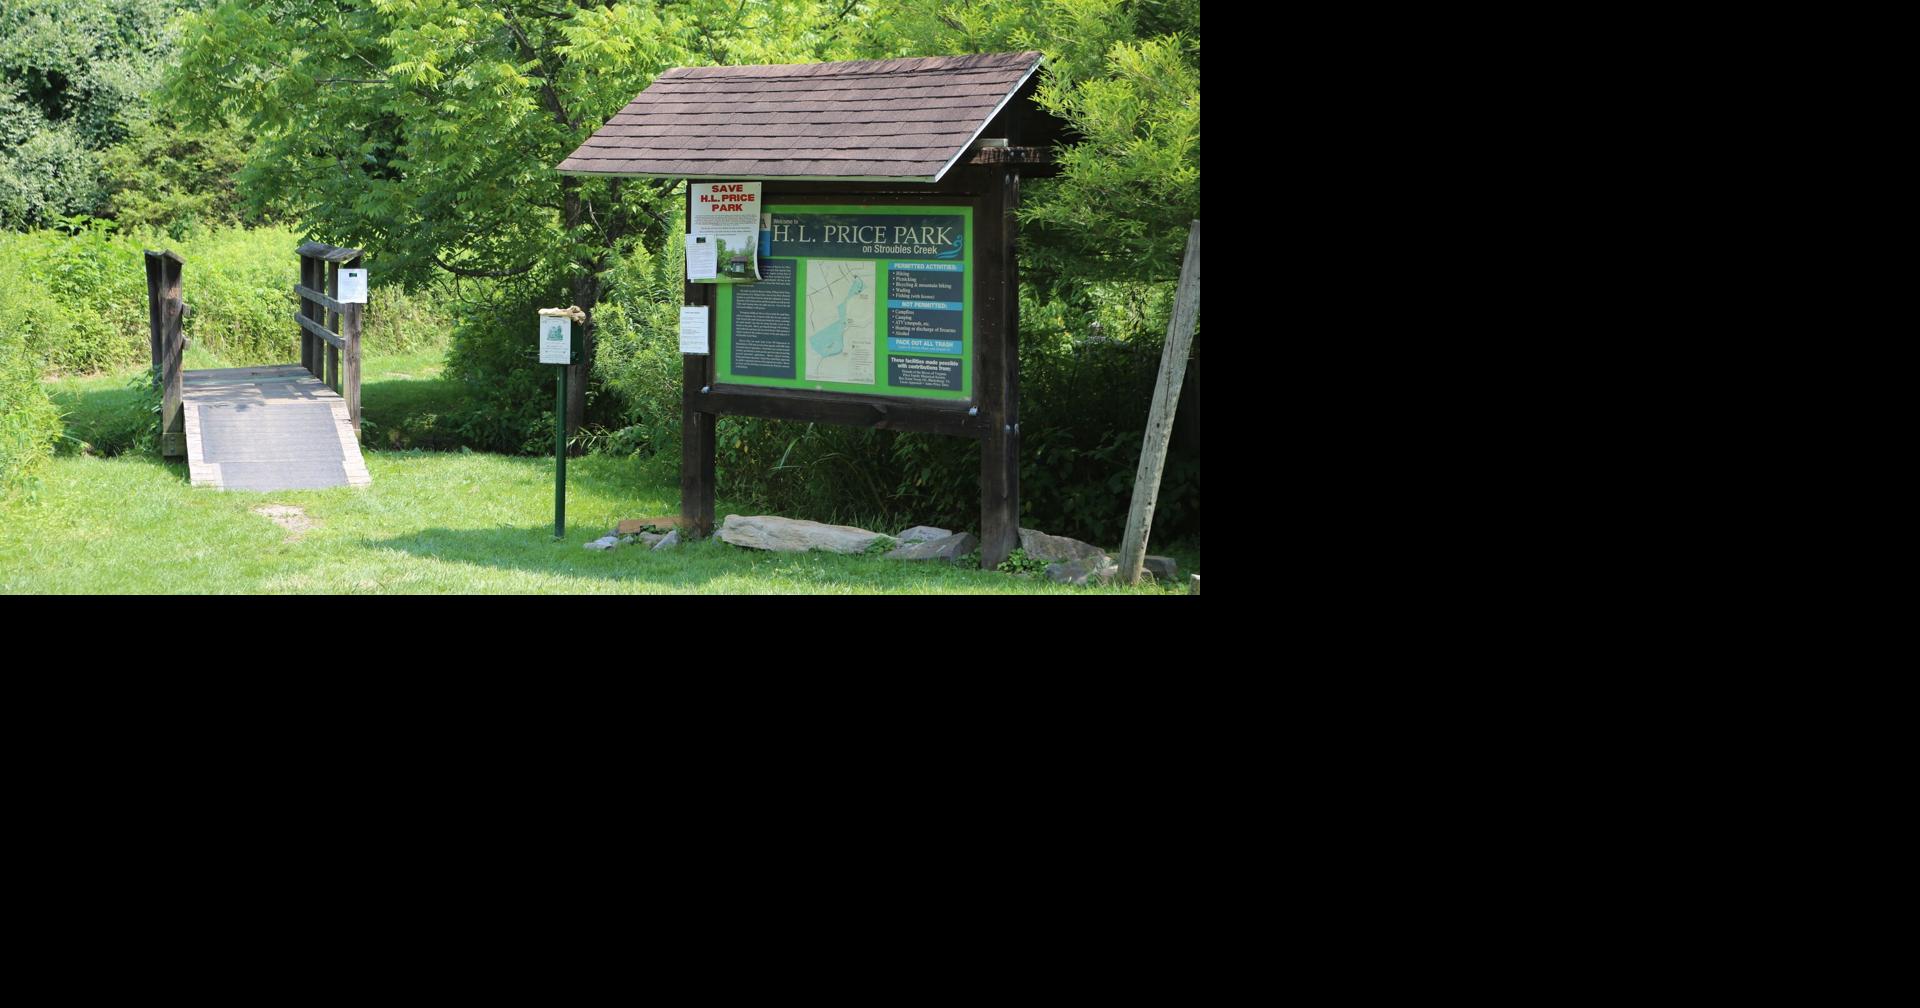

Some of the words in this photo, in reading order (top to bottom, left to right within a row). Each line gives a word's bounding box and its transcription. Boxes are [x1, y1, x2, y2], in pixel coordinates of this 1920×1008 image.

[722, 194, 755, 202] PRICE
[712, 204, 743, 212] PARK
[824, 226, 887, 244] PRICE
[894, 226, 952, 245] PARK
[862, 245, 872, 253] on
[874, 244, 912, 254] Stroubles
[913, 245, 938, 254] Creek
